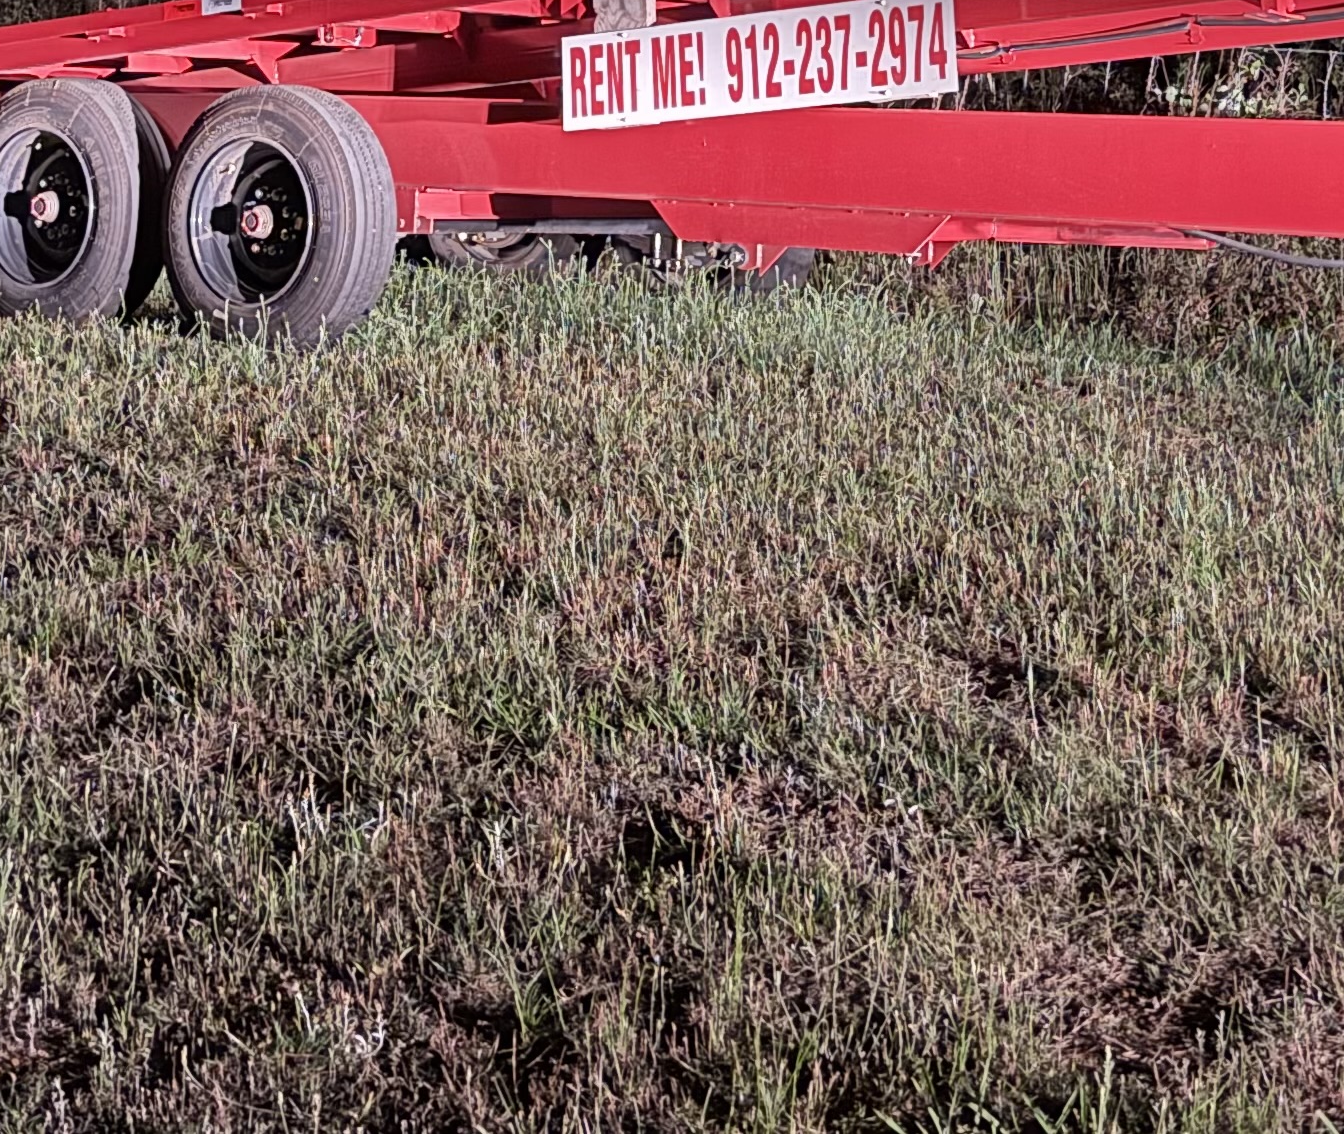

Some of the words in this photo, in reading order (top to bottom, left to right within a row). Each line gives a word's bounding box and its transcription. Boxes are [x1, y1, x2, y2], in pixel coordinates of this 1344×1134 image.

[569, 39, 641, 118] RENT
[651, 31, 706, 110] ME!
[725, 1, 948, 103] 912-237-2974
